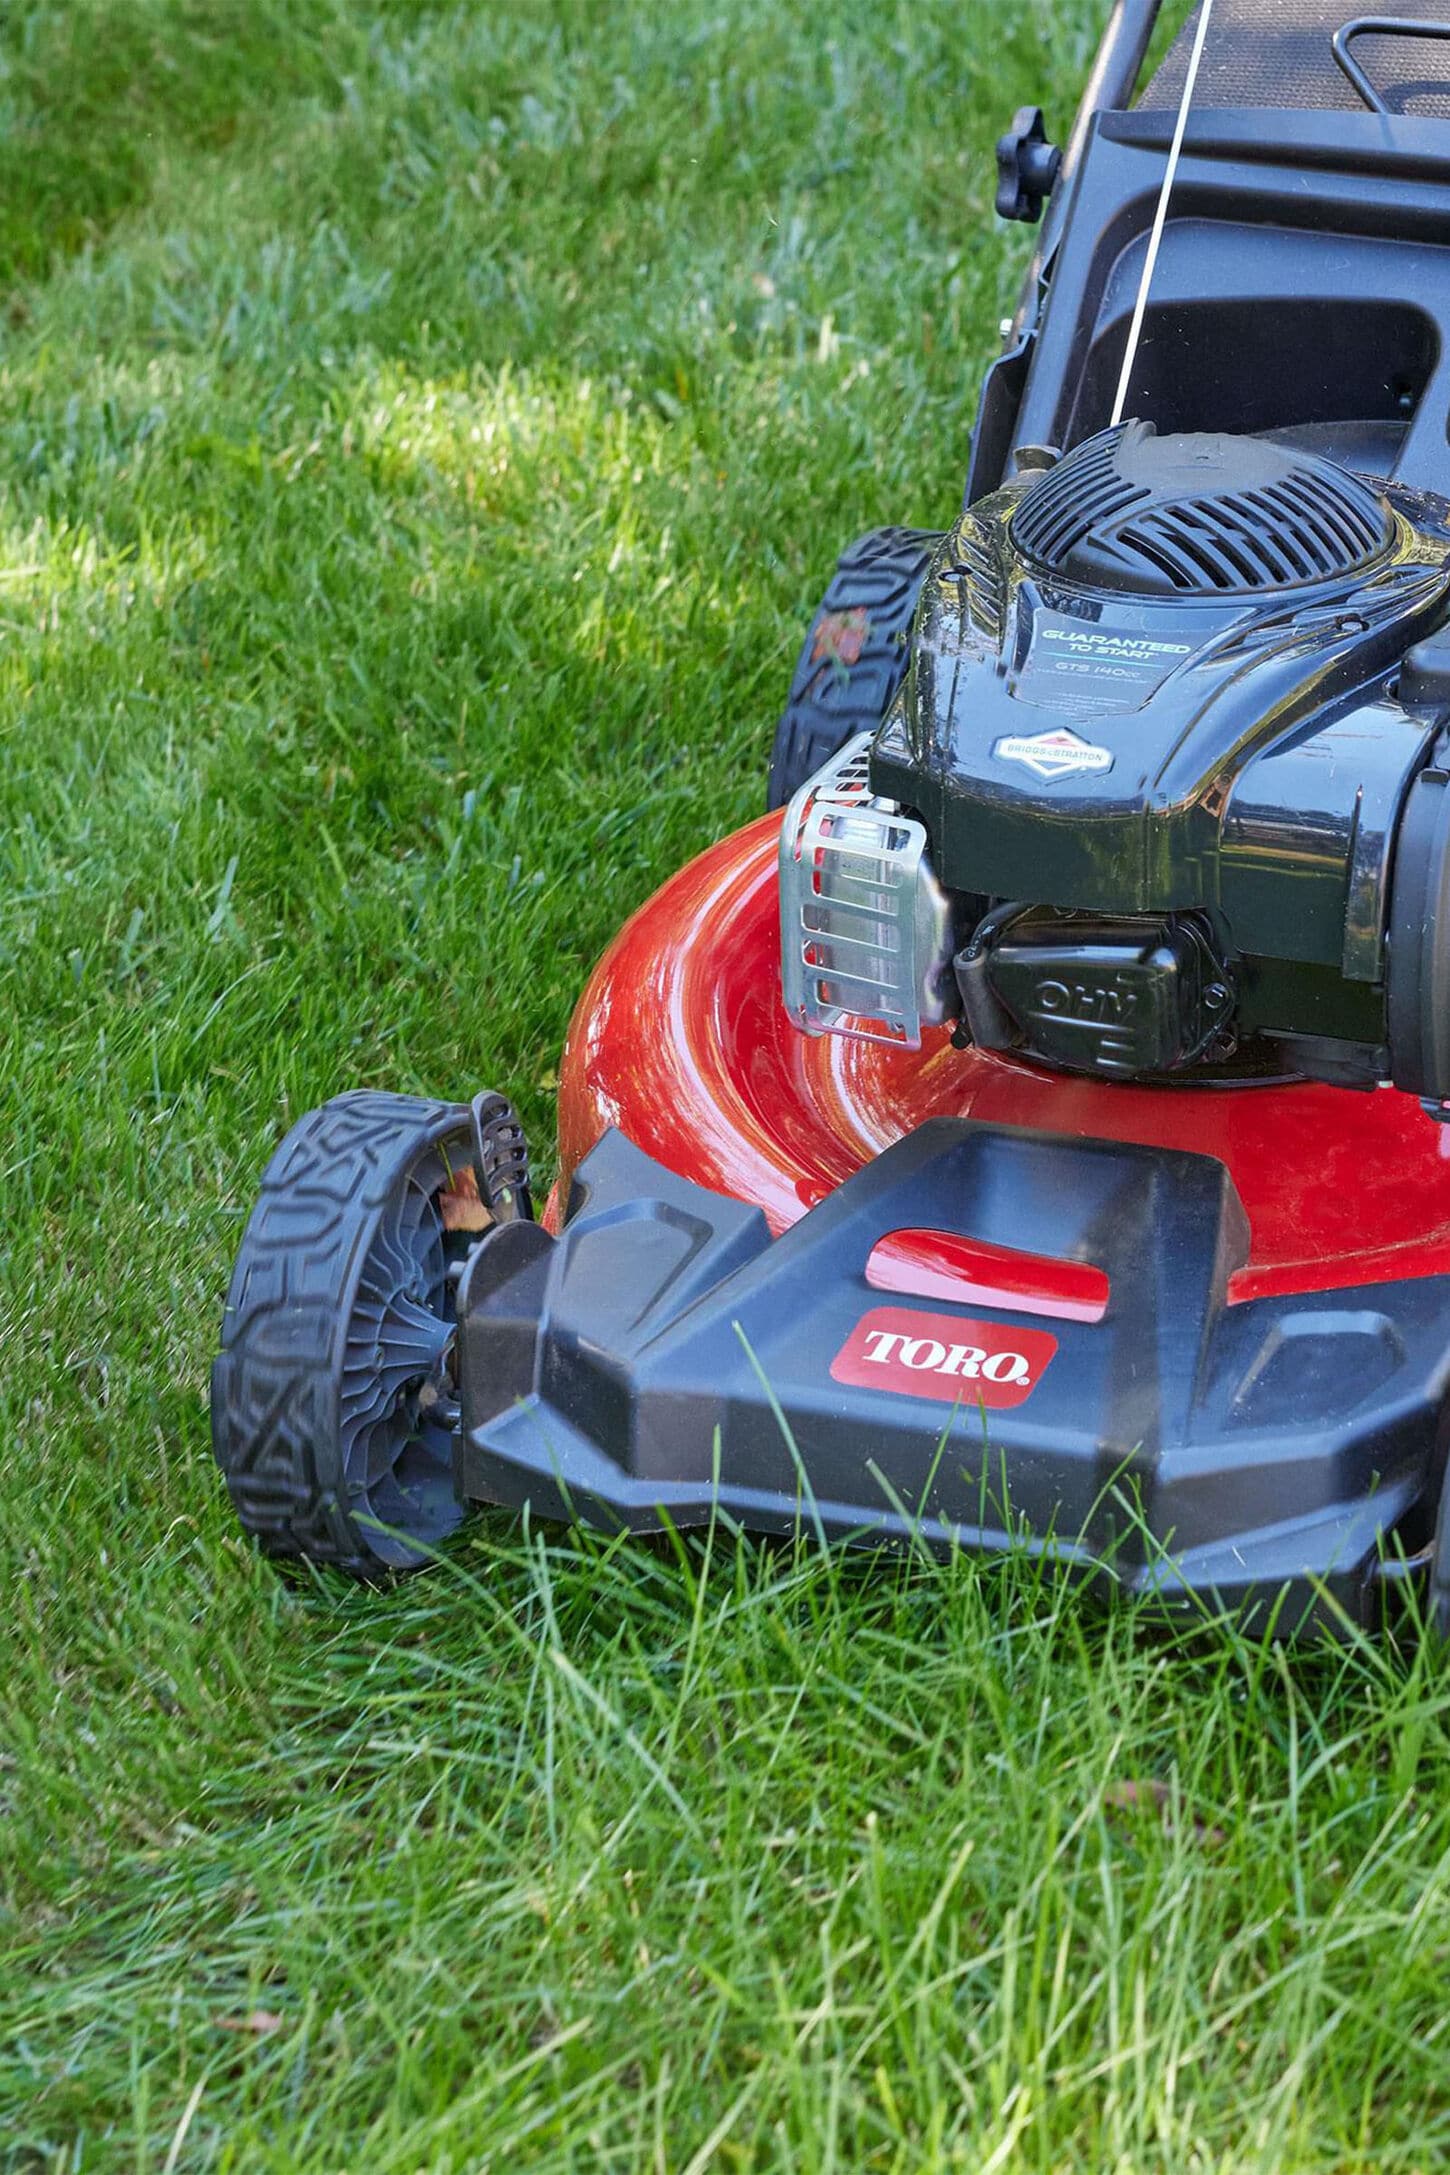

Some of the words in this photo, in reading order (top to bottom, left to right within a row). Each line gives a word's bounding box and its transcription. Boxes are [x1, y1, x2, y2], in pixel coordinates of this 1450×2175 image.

[1042, 629, 1191, 654] GUARANTEED
[1069, 643, 1092, 652] TO
[1094, 646, 1155, 659] START
[1055, 662, 1090, 672] GTS
[1094, 666, 1141, 678] 140cc
[862, 1330, 1029, 1383] TORO
